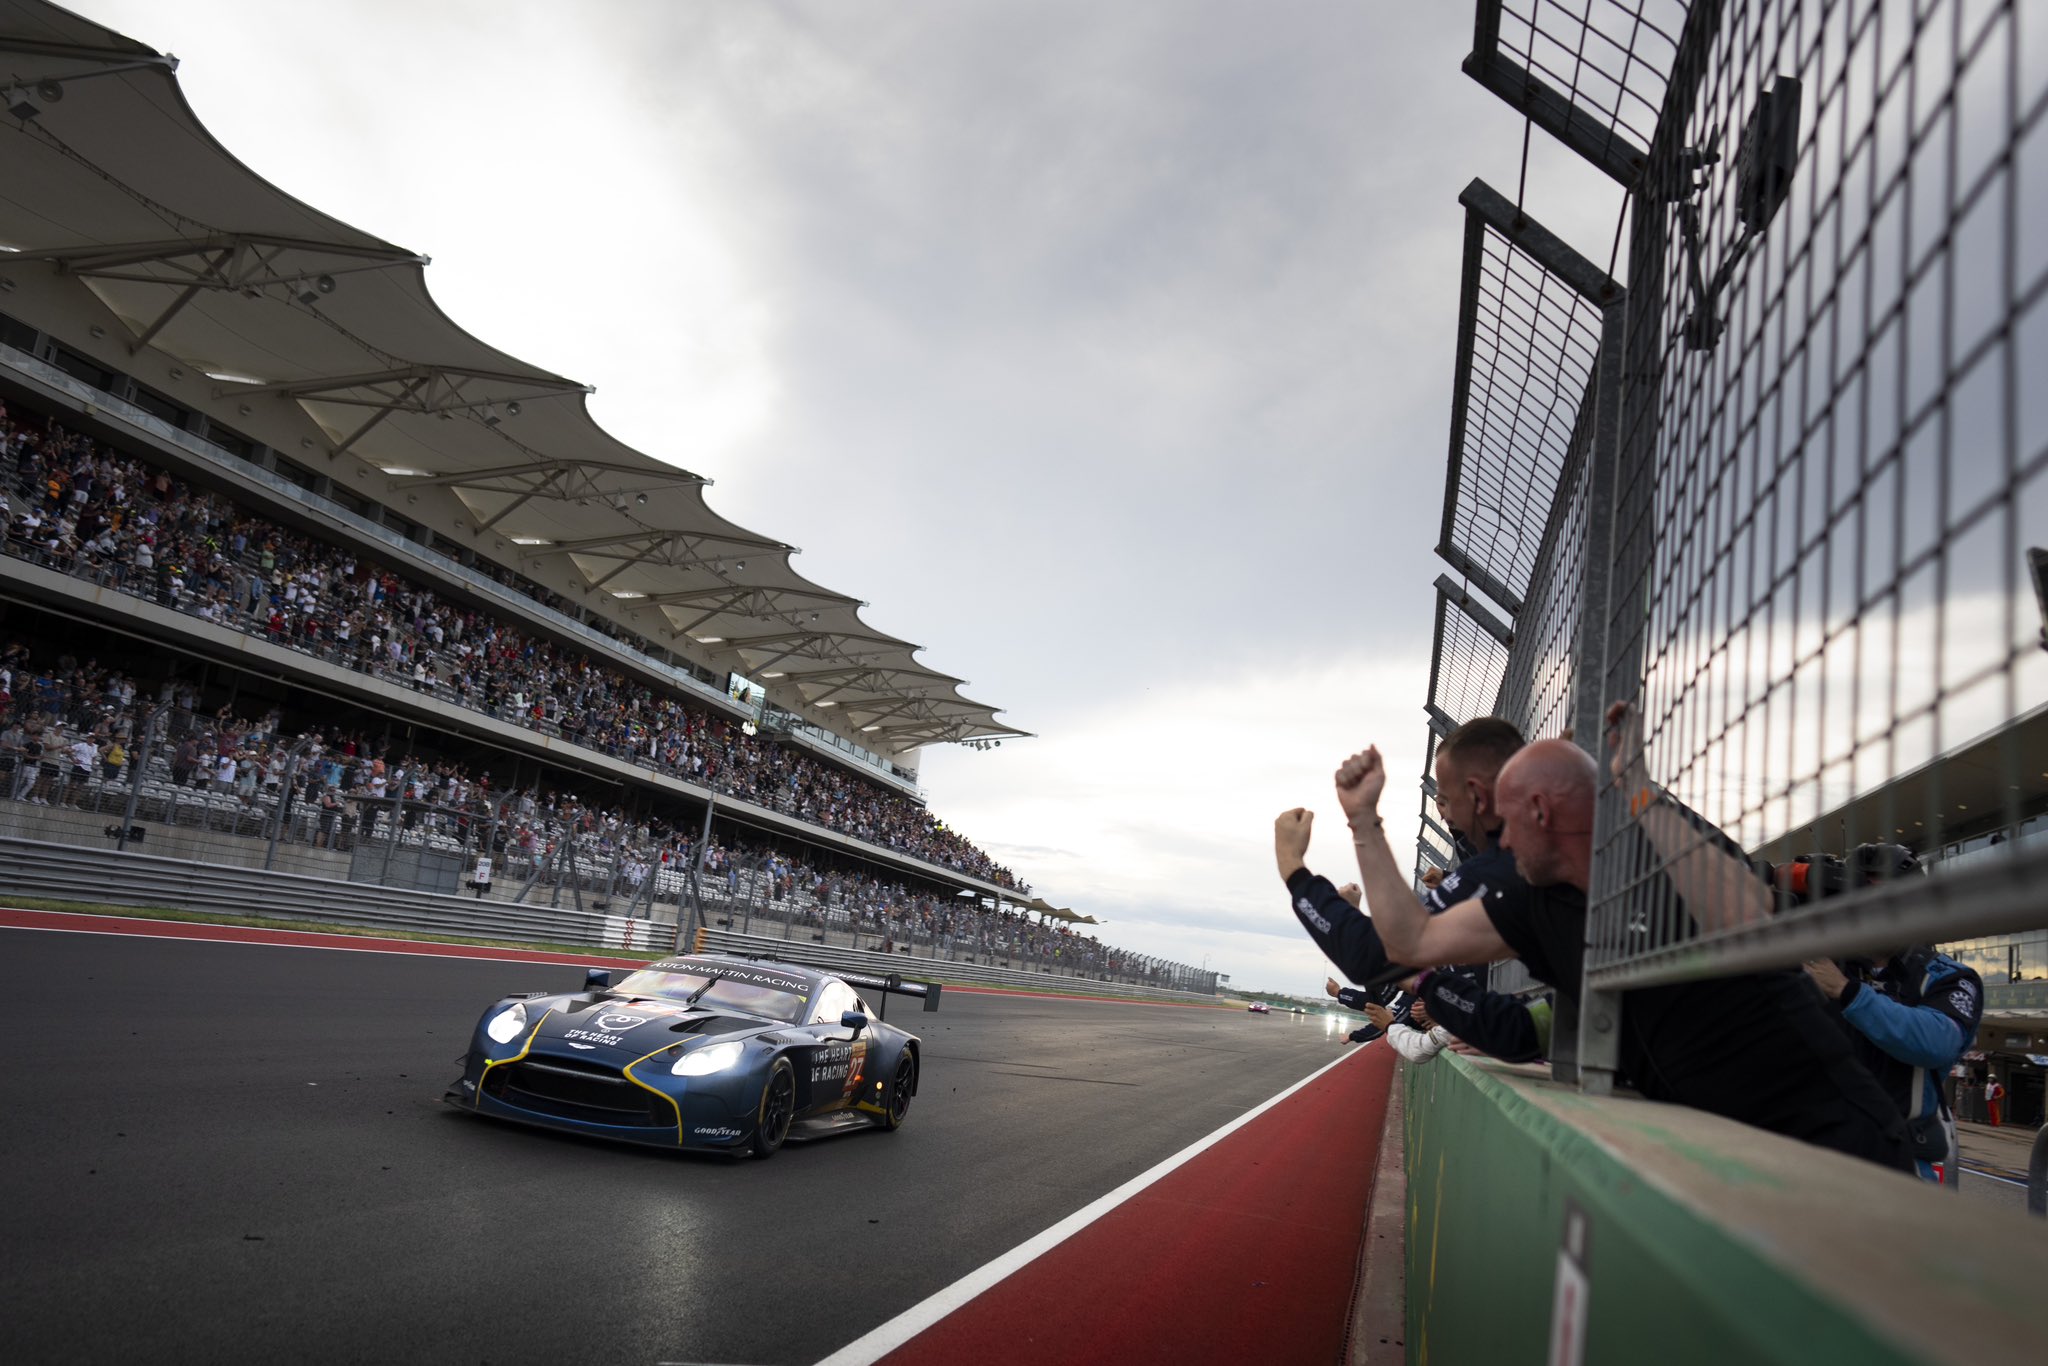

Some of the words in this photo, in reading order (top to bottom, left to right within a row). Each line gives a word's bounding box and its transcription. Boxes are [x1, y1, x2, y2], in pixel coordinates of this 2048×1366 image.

[650, 961, 696, 971] ASTON
[696, 966, 751, 979] MARTIN
[753, 974, 809, 992] RACING
[579, 1035, 617, 1046] RACING
[589, 1032, 624, 1042] HEART
[830, 1046, 853, 1062] HEART
[821, 1064, 849, 1081] RACING
[845, 1057, 865, 1086] 27
[693, 1126, 742, 1137] GOODYEAR
